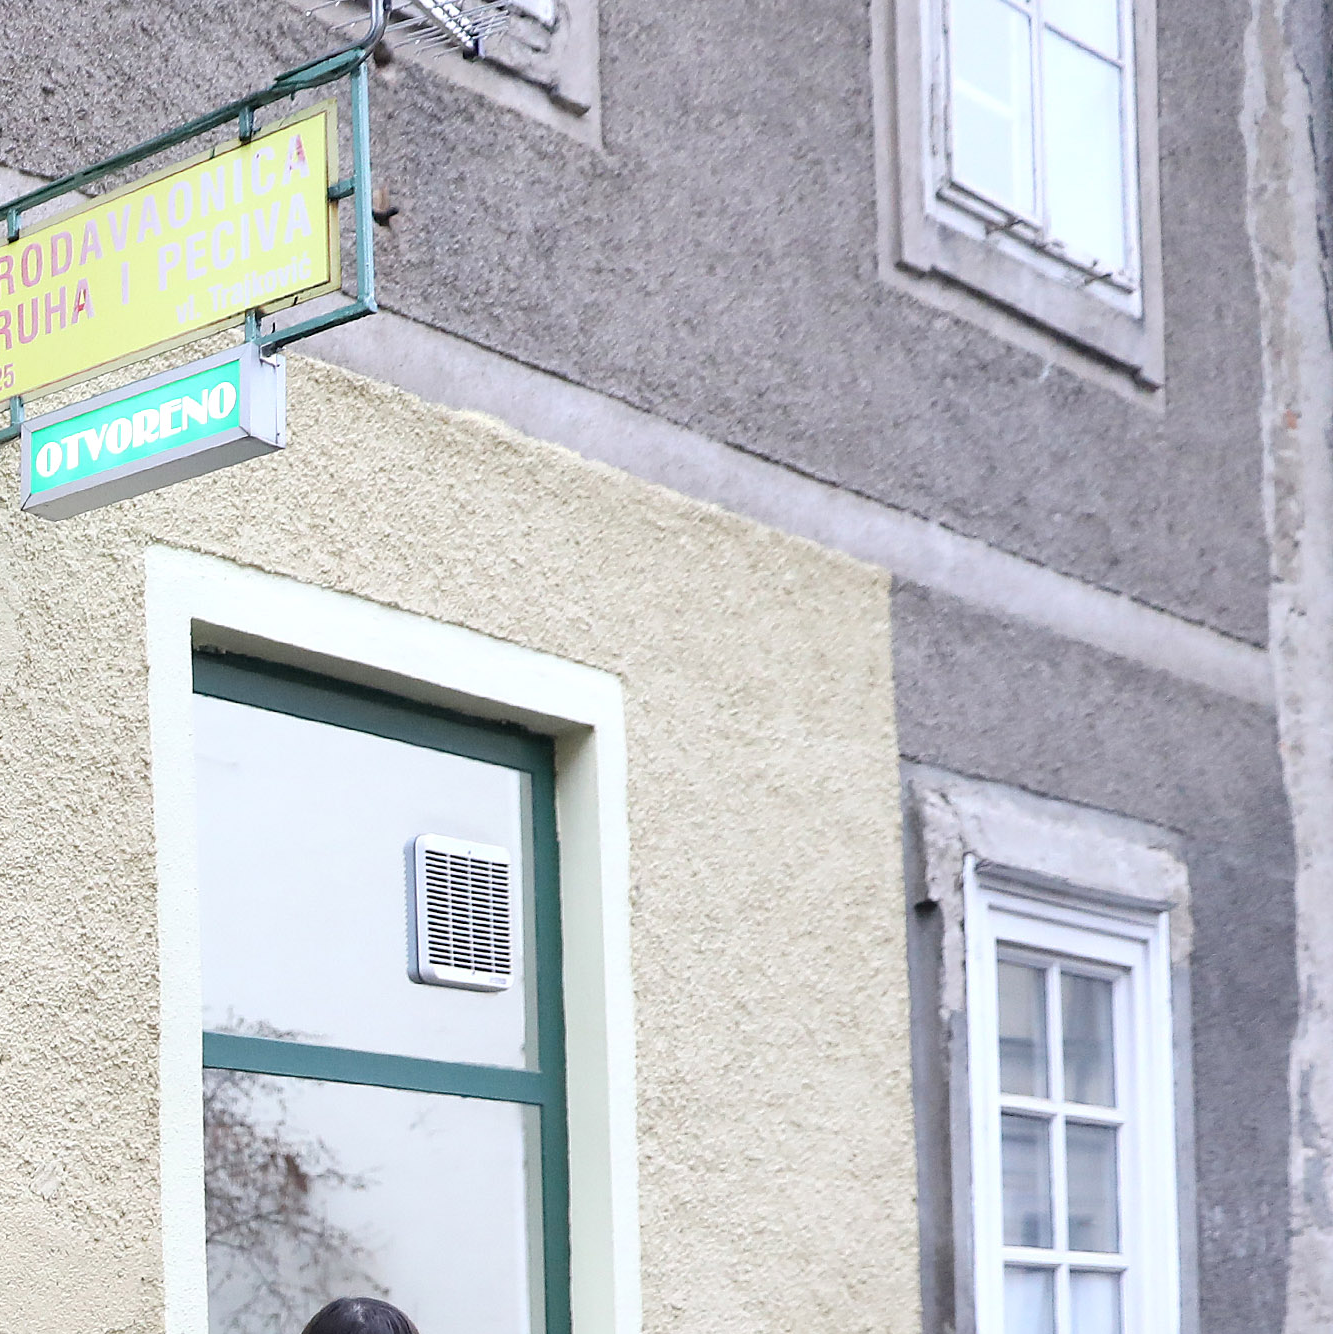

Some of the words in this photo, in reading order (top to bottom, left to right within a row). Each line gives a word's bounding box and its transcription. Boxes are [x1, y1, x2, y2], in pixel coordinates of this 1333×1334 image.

[120, 261, 130, 306] I
[157, 192, 313, 292] PECIVA
[35, 380, 237, 479] OTVORENO
